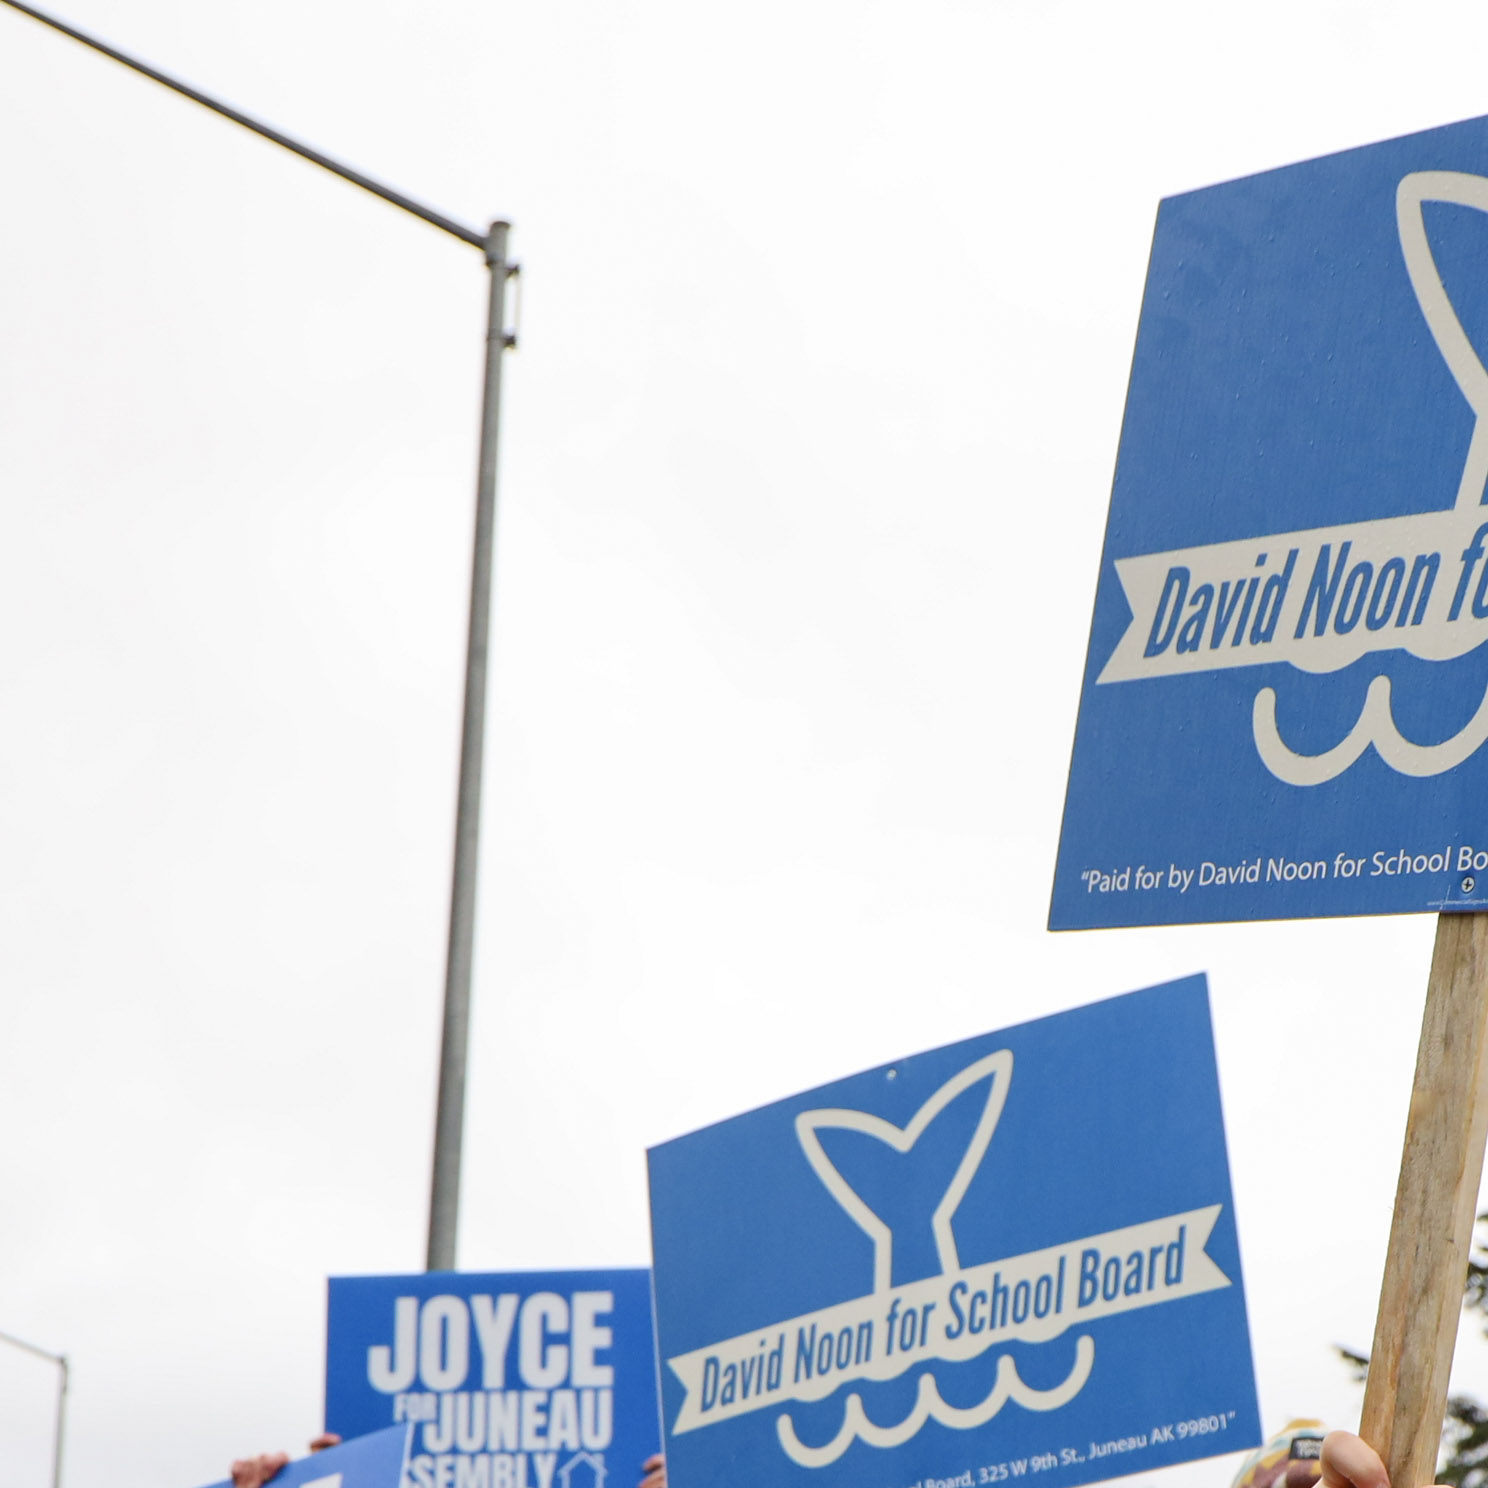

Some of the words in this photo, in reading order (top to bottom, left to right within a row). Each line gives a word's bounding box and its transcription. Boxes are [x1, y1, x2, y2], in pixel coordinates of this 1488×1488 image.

[1143, 549, 1299, 658] David
[1293, 540, 1441, 639] Noon
[1134, 864, 1164, 890] for
[1167, 863, 1194, 892] by
[1198, 858, 1261, 886] David
[1266, 855, 1327, 881] Noon
[1332, 853, 1366, 878] for
[1370, 846, 1451, 876] School
[367, 1291, 615, 1395] JOYCE
[699, 1332, 785, 1414] David
[793, 1318, 874, 1384] Noon
[885, 1298, 936, 1357] for
[945, 1255, 1067, 1341] School
[1077, 1224, 1186, 1309] Board
[422, 1389, 613, 1454] JUNEAU
[979, 1464, 1009, 1485] 325
[1010, 1459, 1030, 1477] W
[1031, 1452, 1058, 1473] 9th
[1088, 1434, 1148, 1460] Juneau
[1150, 1424, 1175, 1445] AK
